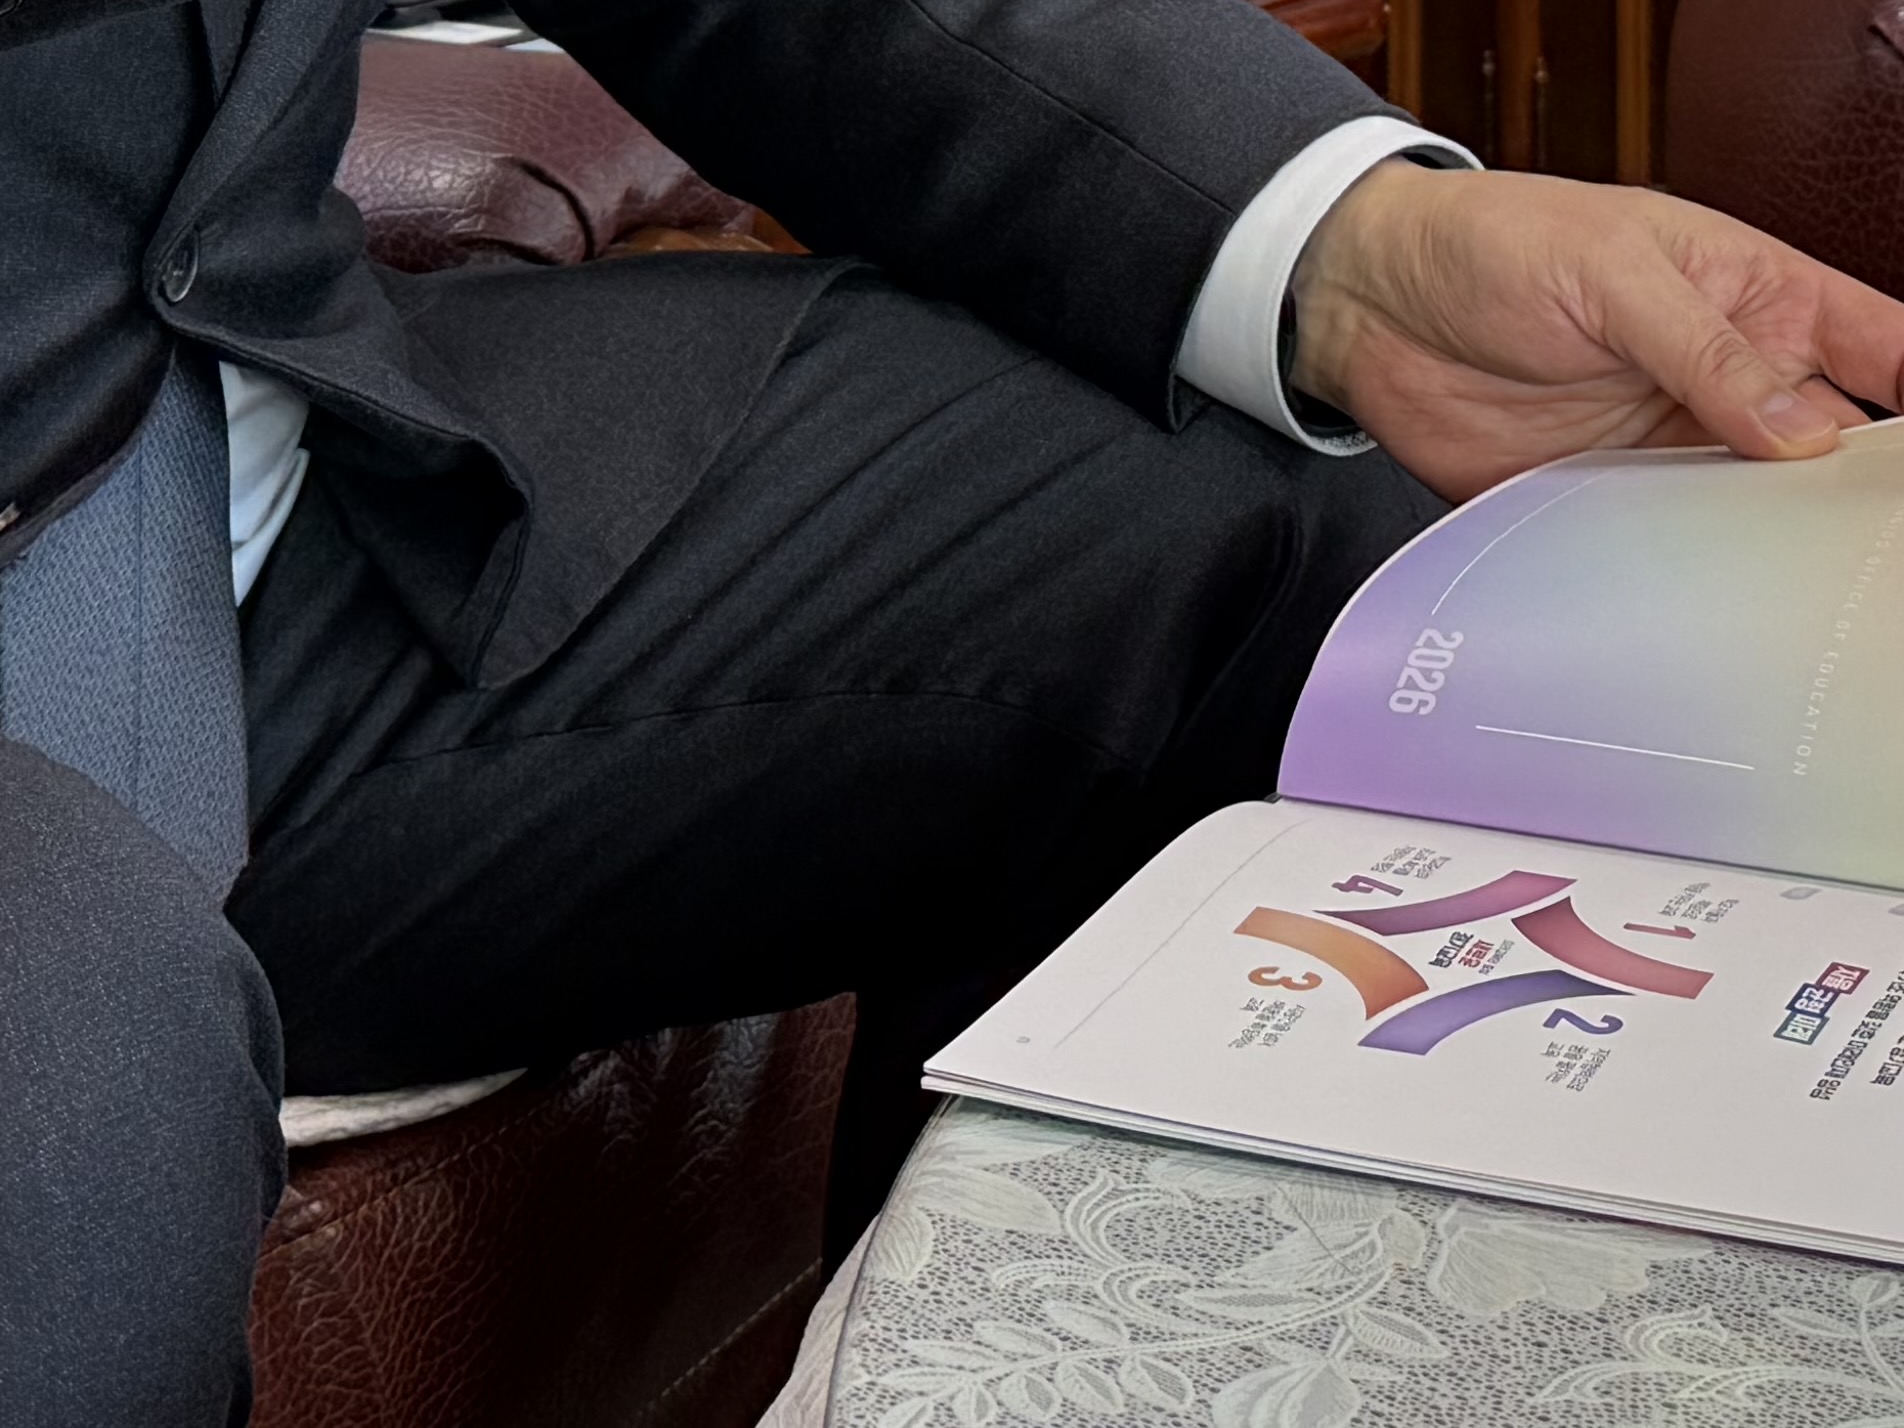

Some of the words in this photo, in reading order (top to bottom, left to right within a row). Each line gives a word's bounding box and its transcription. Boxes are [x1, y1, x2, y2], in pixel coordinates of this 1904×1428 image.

[1388, 628, 1465, 715] 2026
[1793, 650, 1839, 776] EDUCATION
[1331, 874, 1404, 897] 4
[1623, 922, 1696, 940] 1
[1428, 931, 1474, 968] 경기교육
[1248, 966, 1323, 991] 3
[1822, 965, 1861, 991] 자율
[1794, 987, 1835, 1013] 균형
[1542, 1008, 1624, 1035] 2
[1782, 1016, 1822, 1041] 미래
